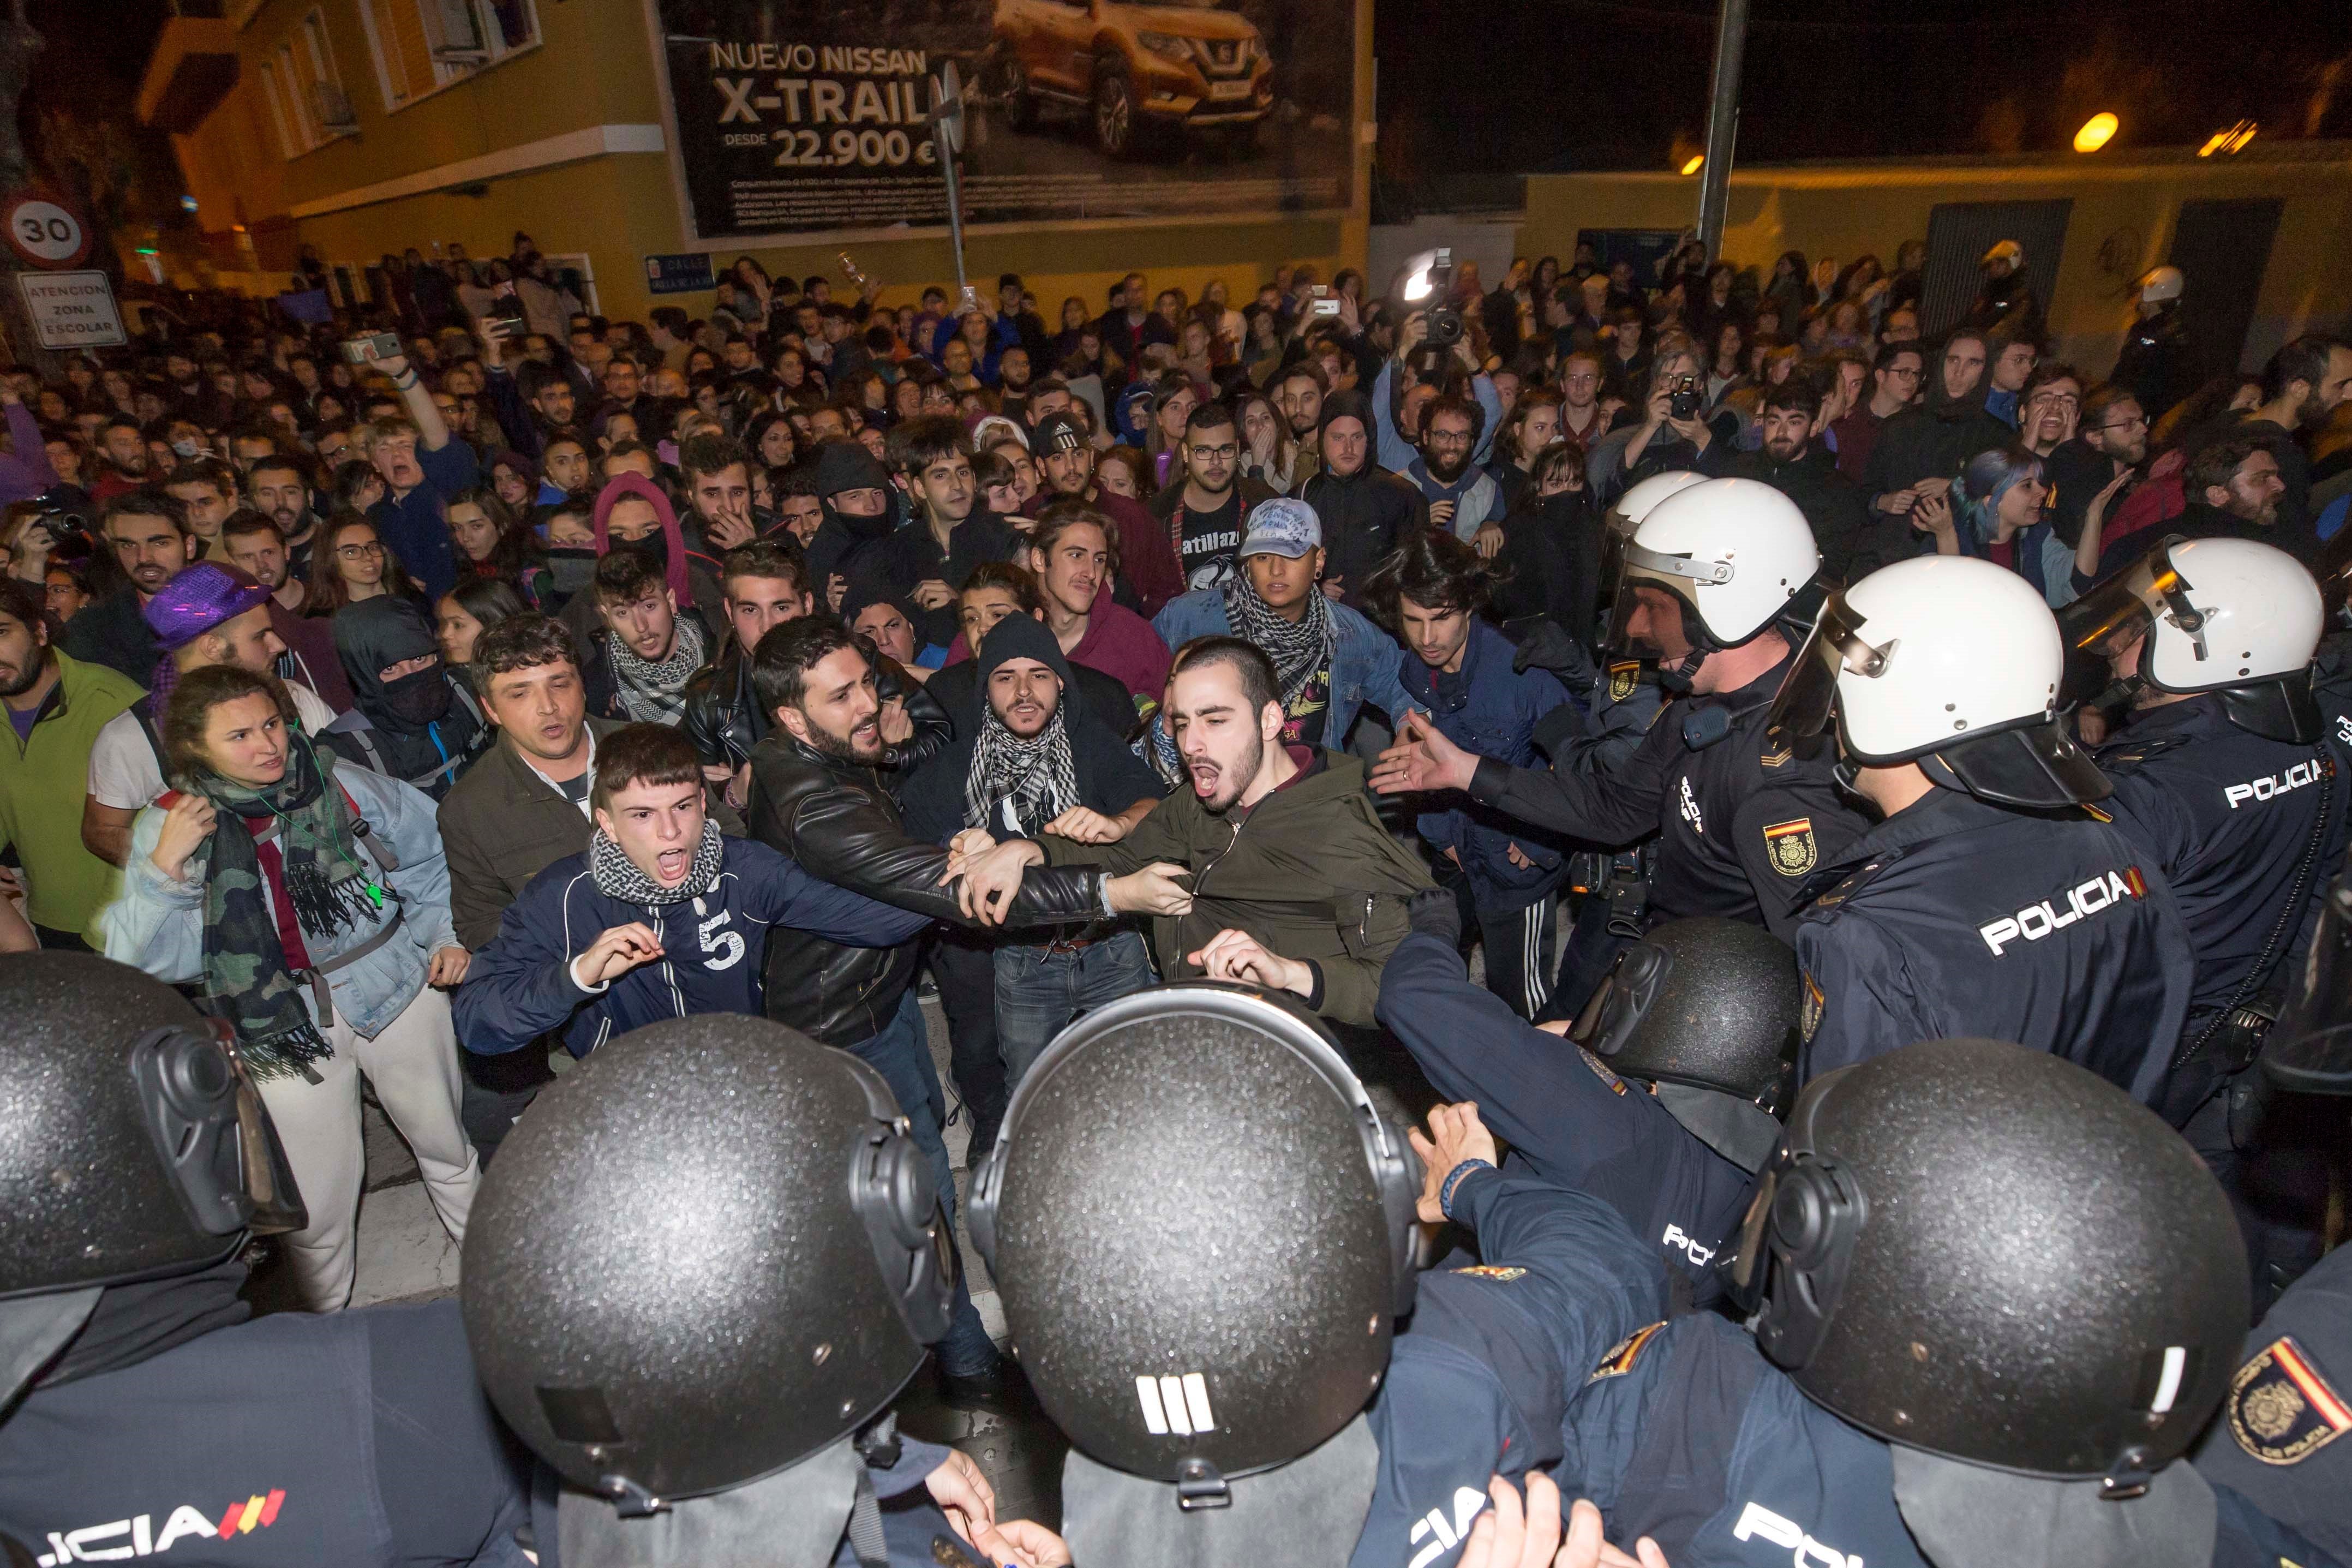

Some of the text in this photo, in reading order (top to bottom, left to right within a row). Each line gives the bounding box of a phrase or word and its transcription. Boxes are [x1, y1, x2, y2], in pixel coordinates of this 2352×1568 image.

[710, 41, 927, 75] NUEVO NISSAN
[713, 76, 929, 125] X-TRAIL
[725, 133, 767, 147] DESDE
[773, 129, 911, 166] 22.900
[22, 218, 71, 243] 30
[46, 322, 113, 334] ESCOLAR
[53, 305, 94, 316] ZONA
[2336, 715, 2352, 733] PO
[2224, 758, 2323, 809] POLICIA
[1979, 870, 2132, 957] POLICIA
[699, 908, 745, 971] 5
[37, 1505, 219, 1568] ICIA
